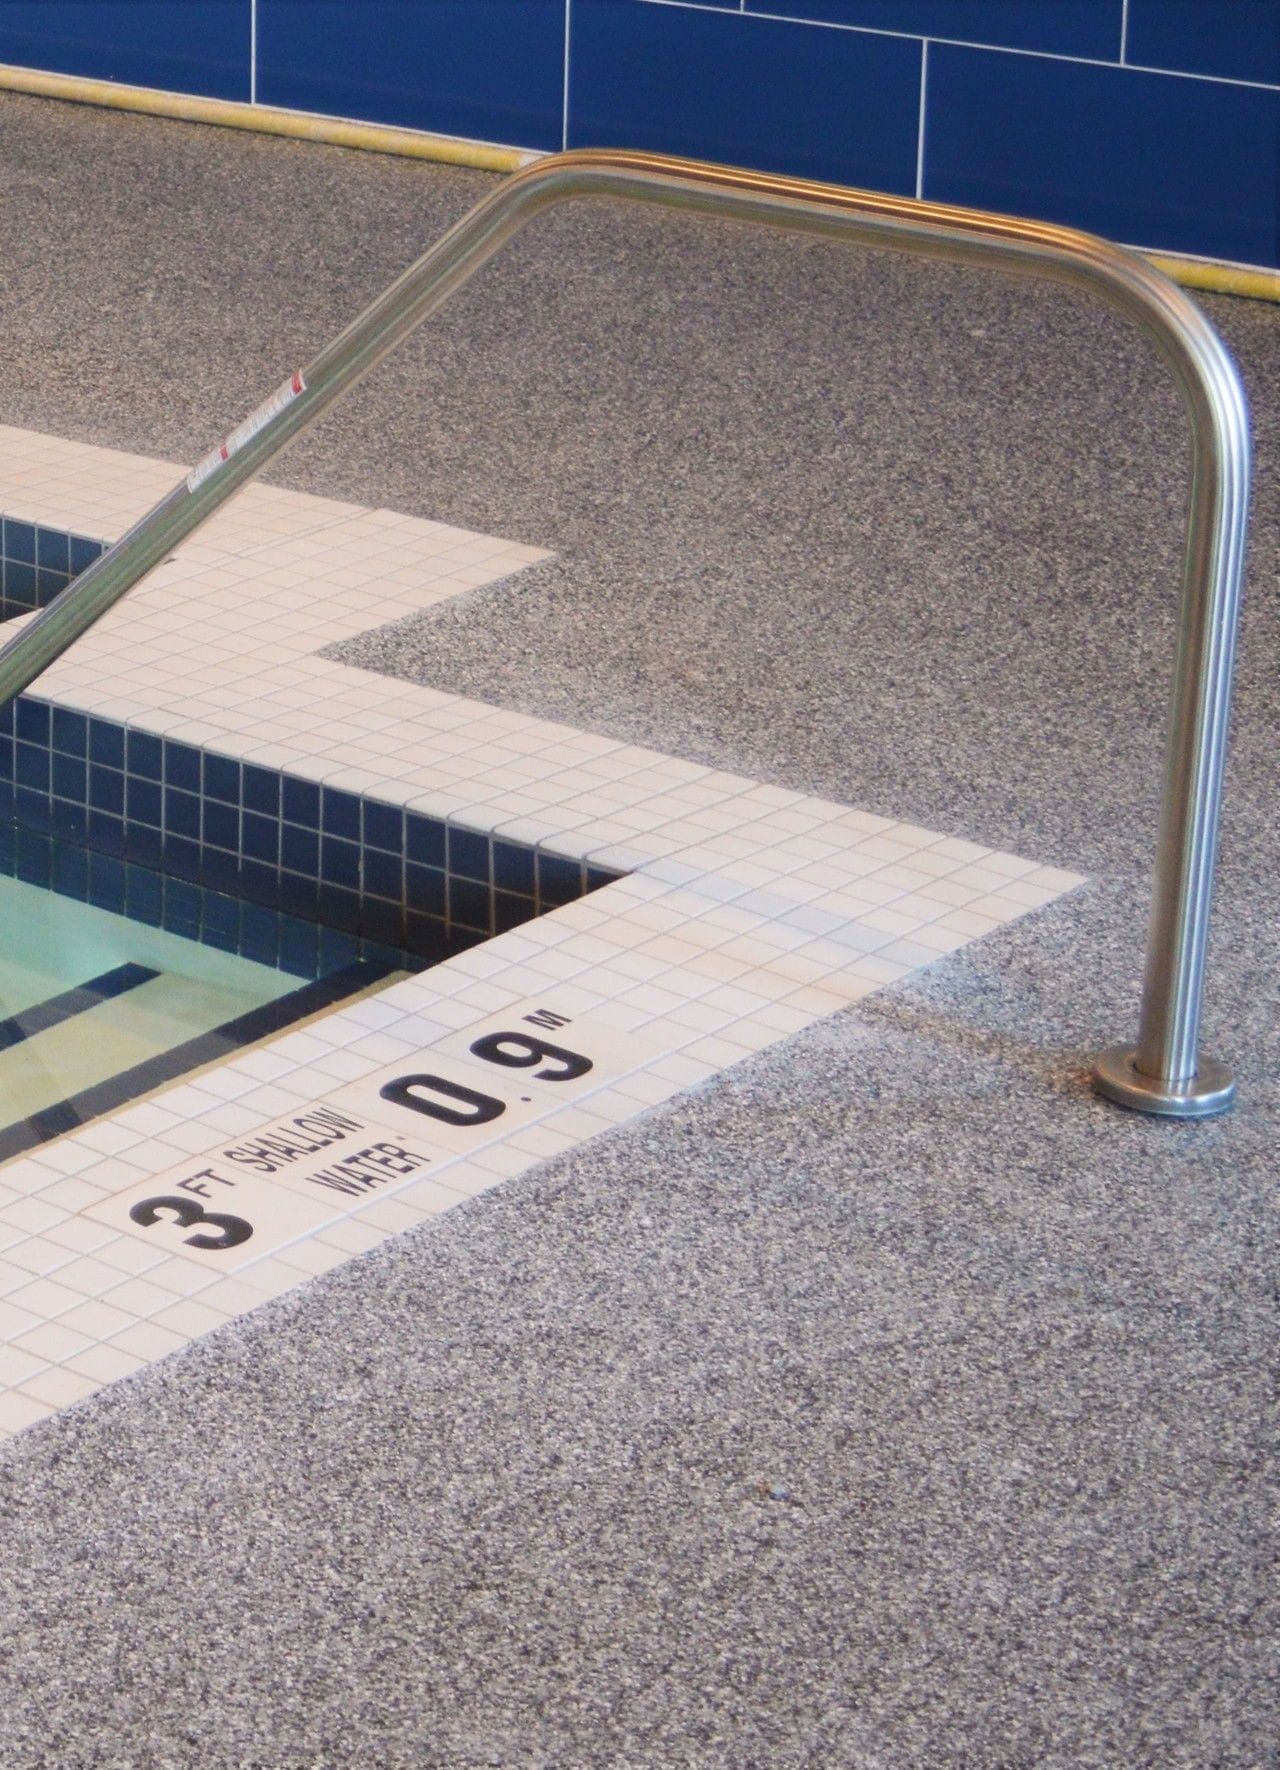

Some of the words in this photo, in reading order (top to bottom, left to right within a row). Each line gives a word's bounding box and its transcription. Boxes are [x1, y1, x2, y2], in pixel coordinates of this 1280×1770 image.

[379, 1031, 594, 1126] 0.9
[522, 1008, 573, 1031] M
[223, 1107, 365, 1172] SHALLOW
[175, 1168, 236, 1198] FT
[305, 1142, 431, 1197] WATER
[129, 1195, 254, 1250] 3
